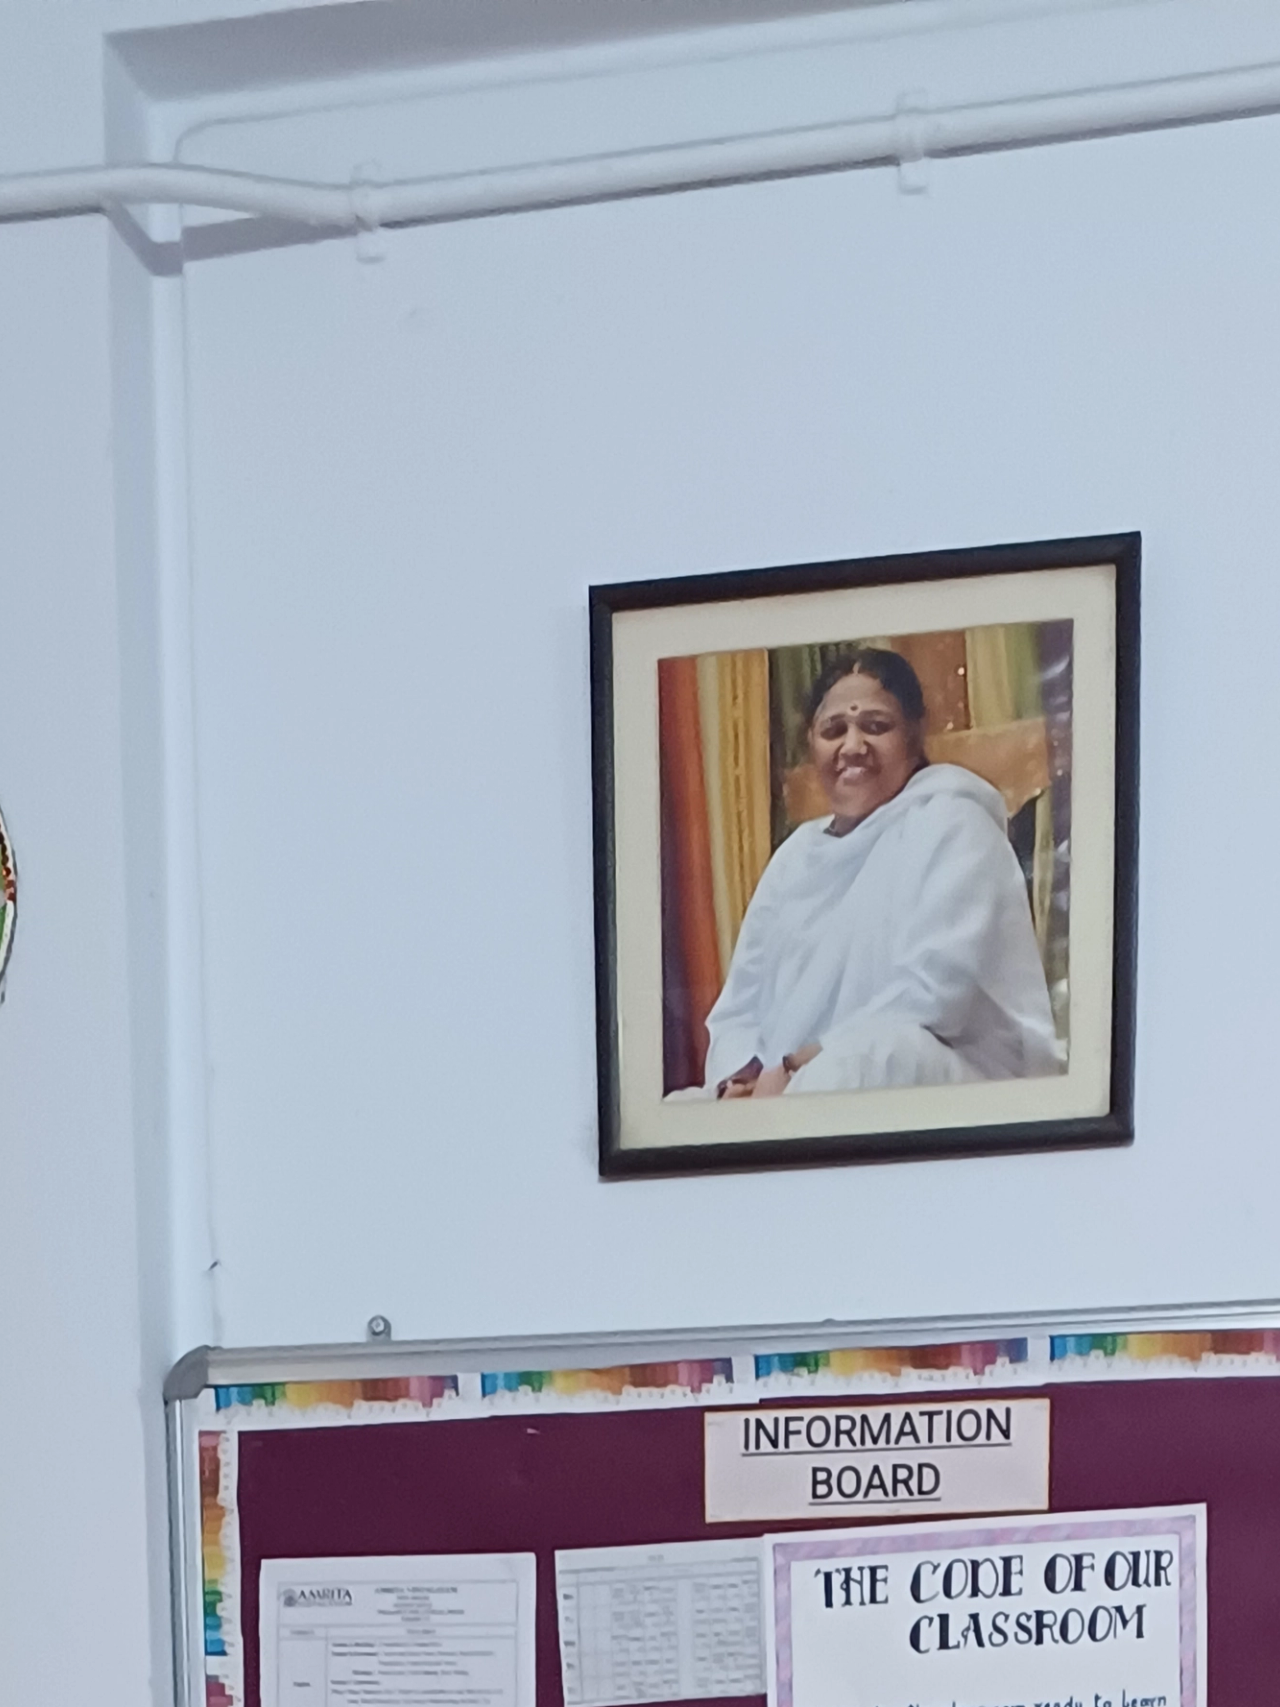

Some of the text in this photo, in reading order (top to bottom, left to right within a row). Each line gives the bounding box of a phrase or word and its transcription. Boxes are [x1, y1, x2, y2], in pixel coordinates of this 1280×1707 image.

[743, 1407, 1012, 1451] INFORMATION
[811, 1462, 941, 1500] BOARD
[815, 1550, 1174, 1609] THE CODE OF OUR
[909, 1604, 1147, 1654] CLASSROOM
